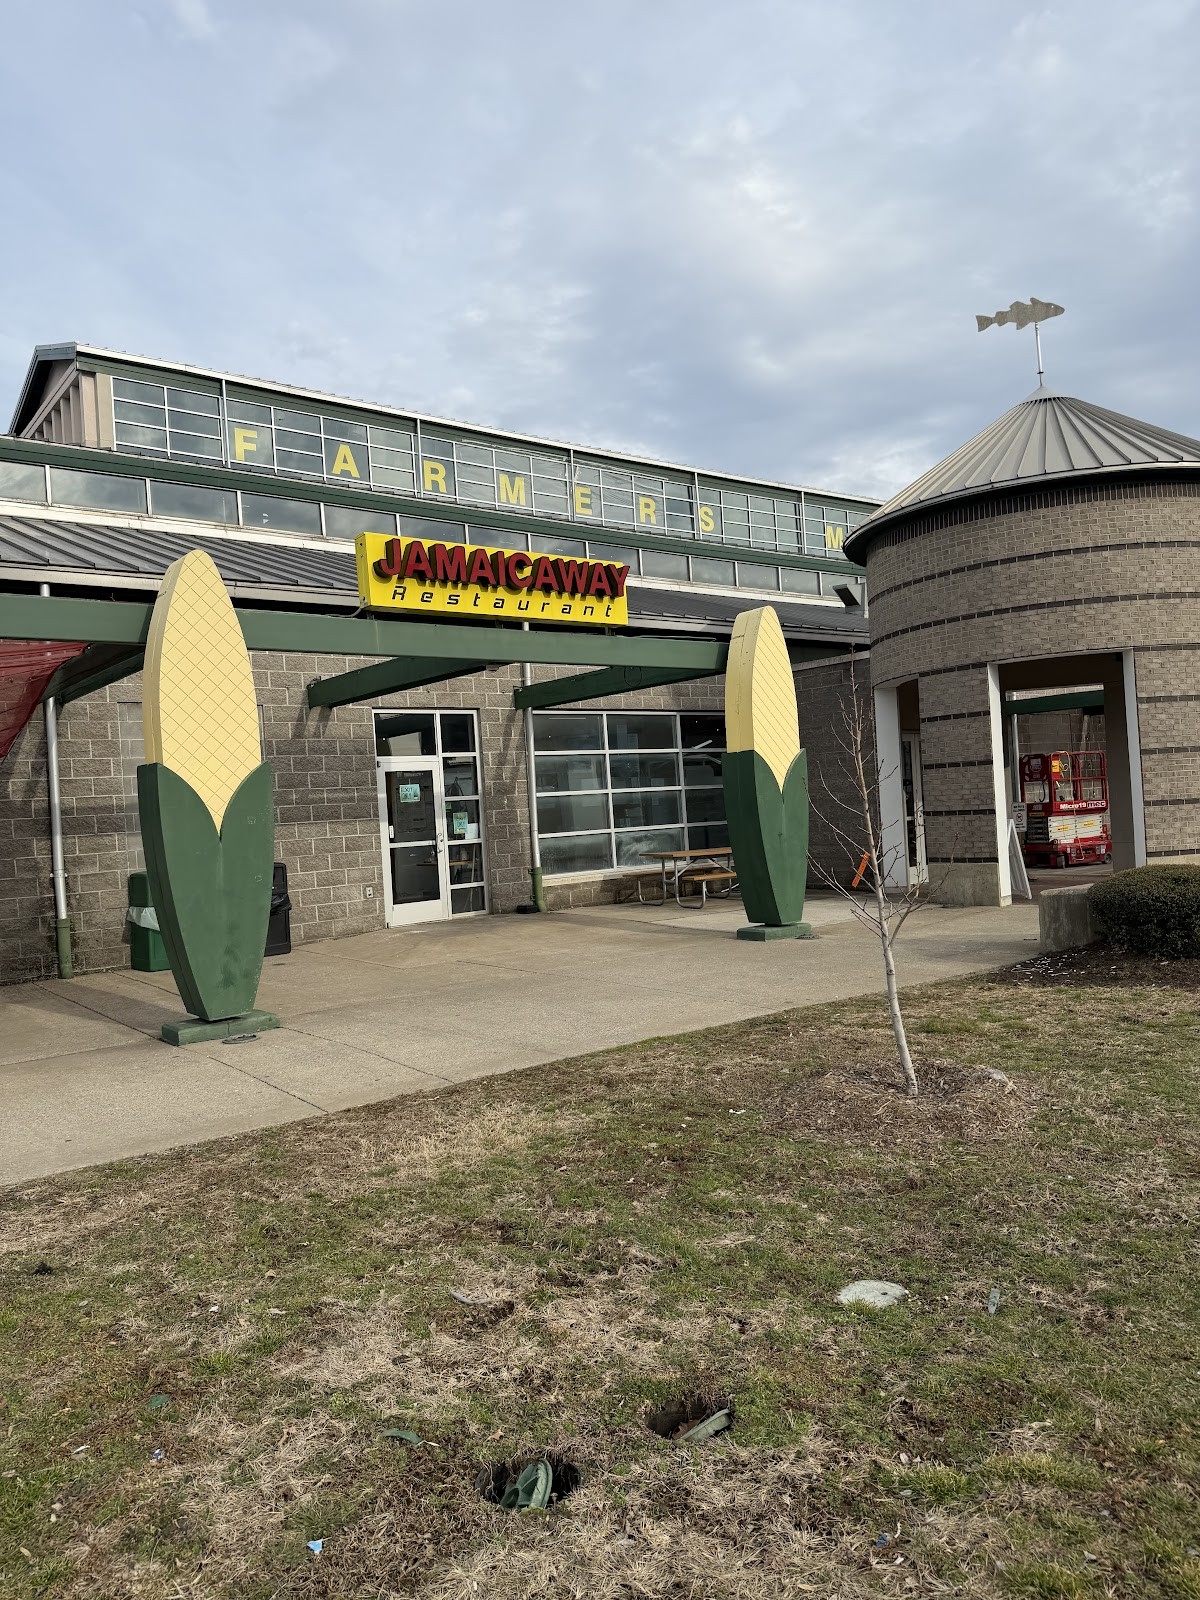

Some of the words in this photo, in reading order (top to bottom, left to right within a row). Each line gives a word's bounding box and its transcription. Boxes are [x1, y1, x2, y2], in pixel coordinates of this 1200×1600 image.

[234, 427, 715, 533] FARMERS
[373, 538, 630, 598] JAMAICAWAY
[392, 585, 613, 618] Restaurant
